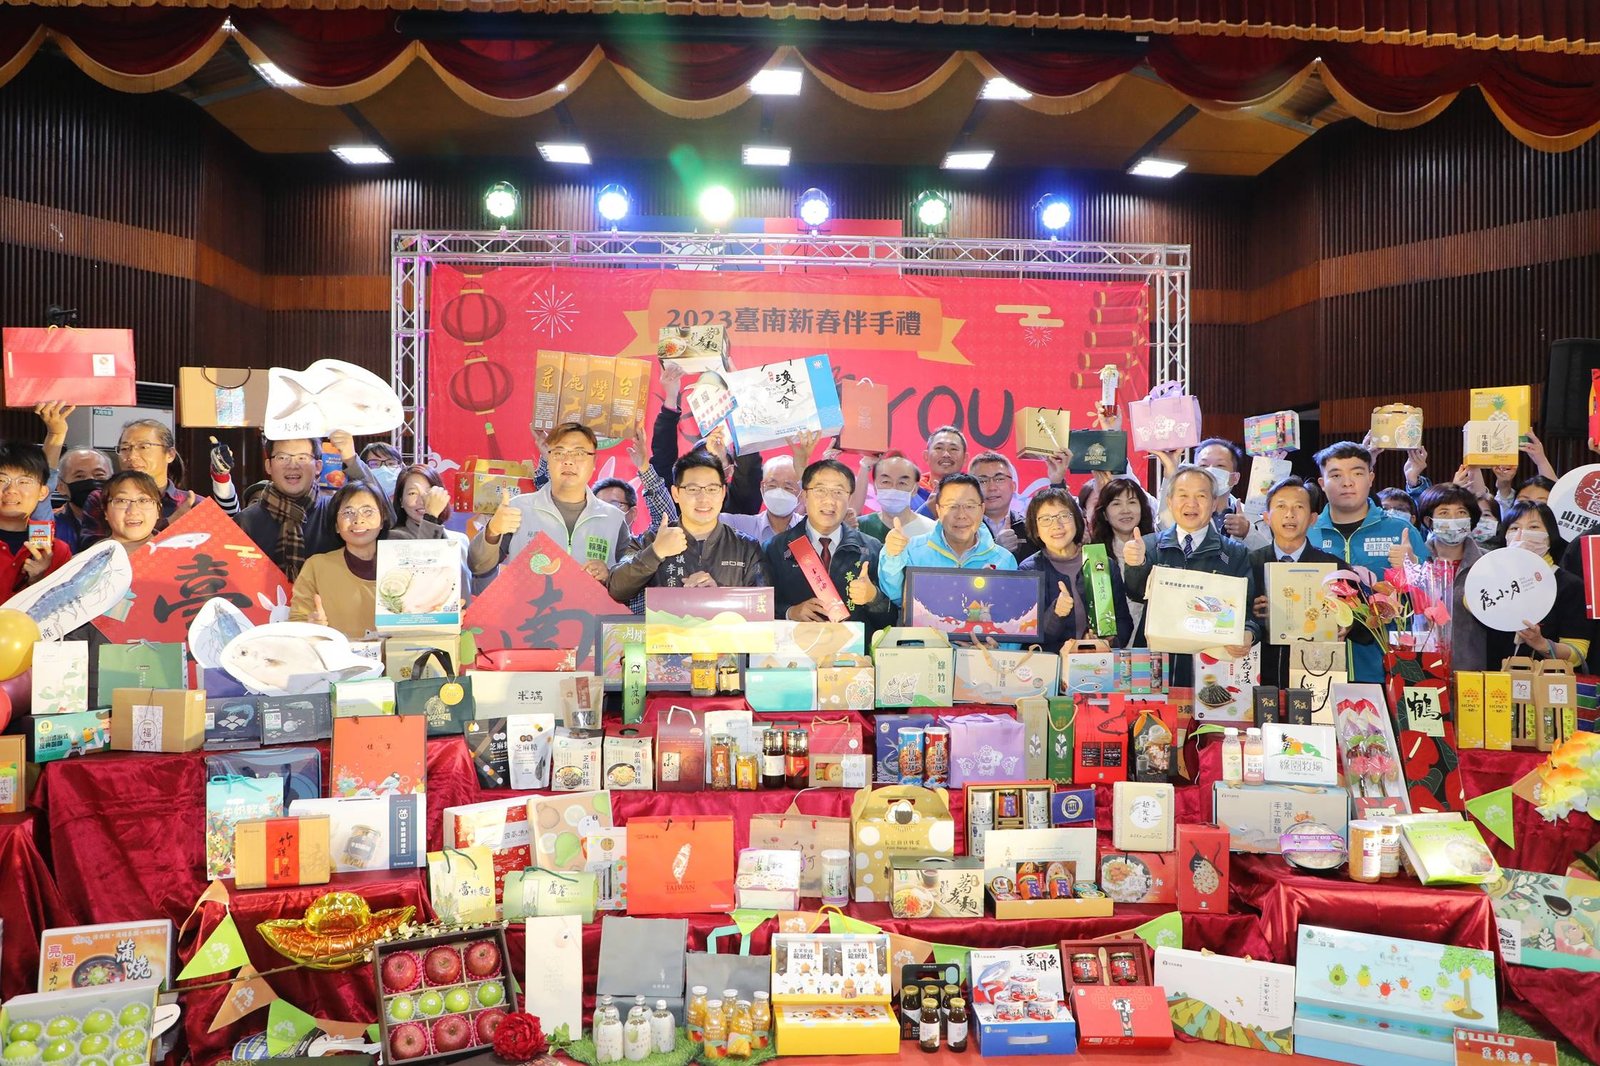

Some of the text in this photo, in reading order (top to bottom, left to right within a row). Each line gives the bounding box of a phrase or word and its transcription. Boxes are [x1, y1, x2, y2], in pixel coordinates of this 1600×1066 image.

[666, 307, 922, 338] 2023臺南新春伴手禮
